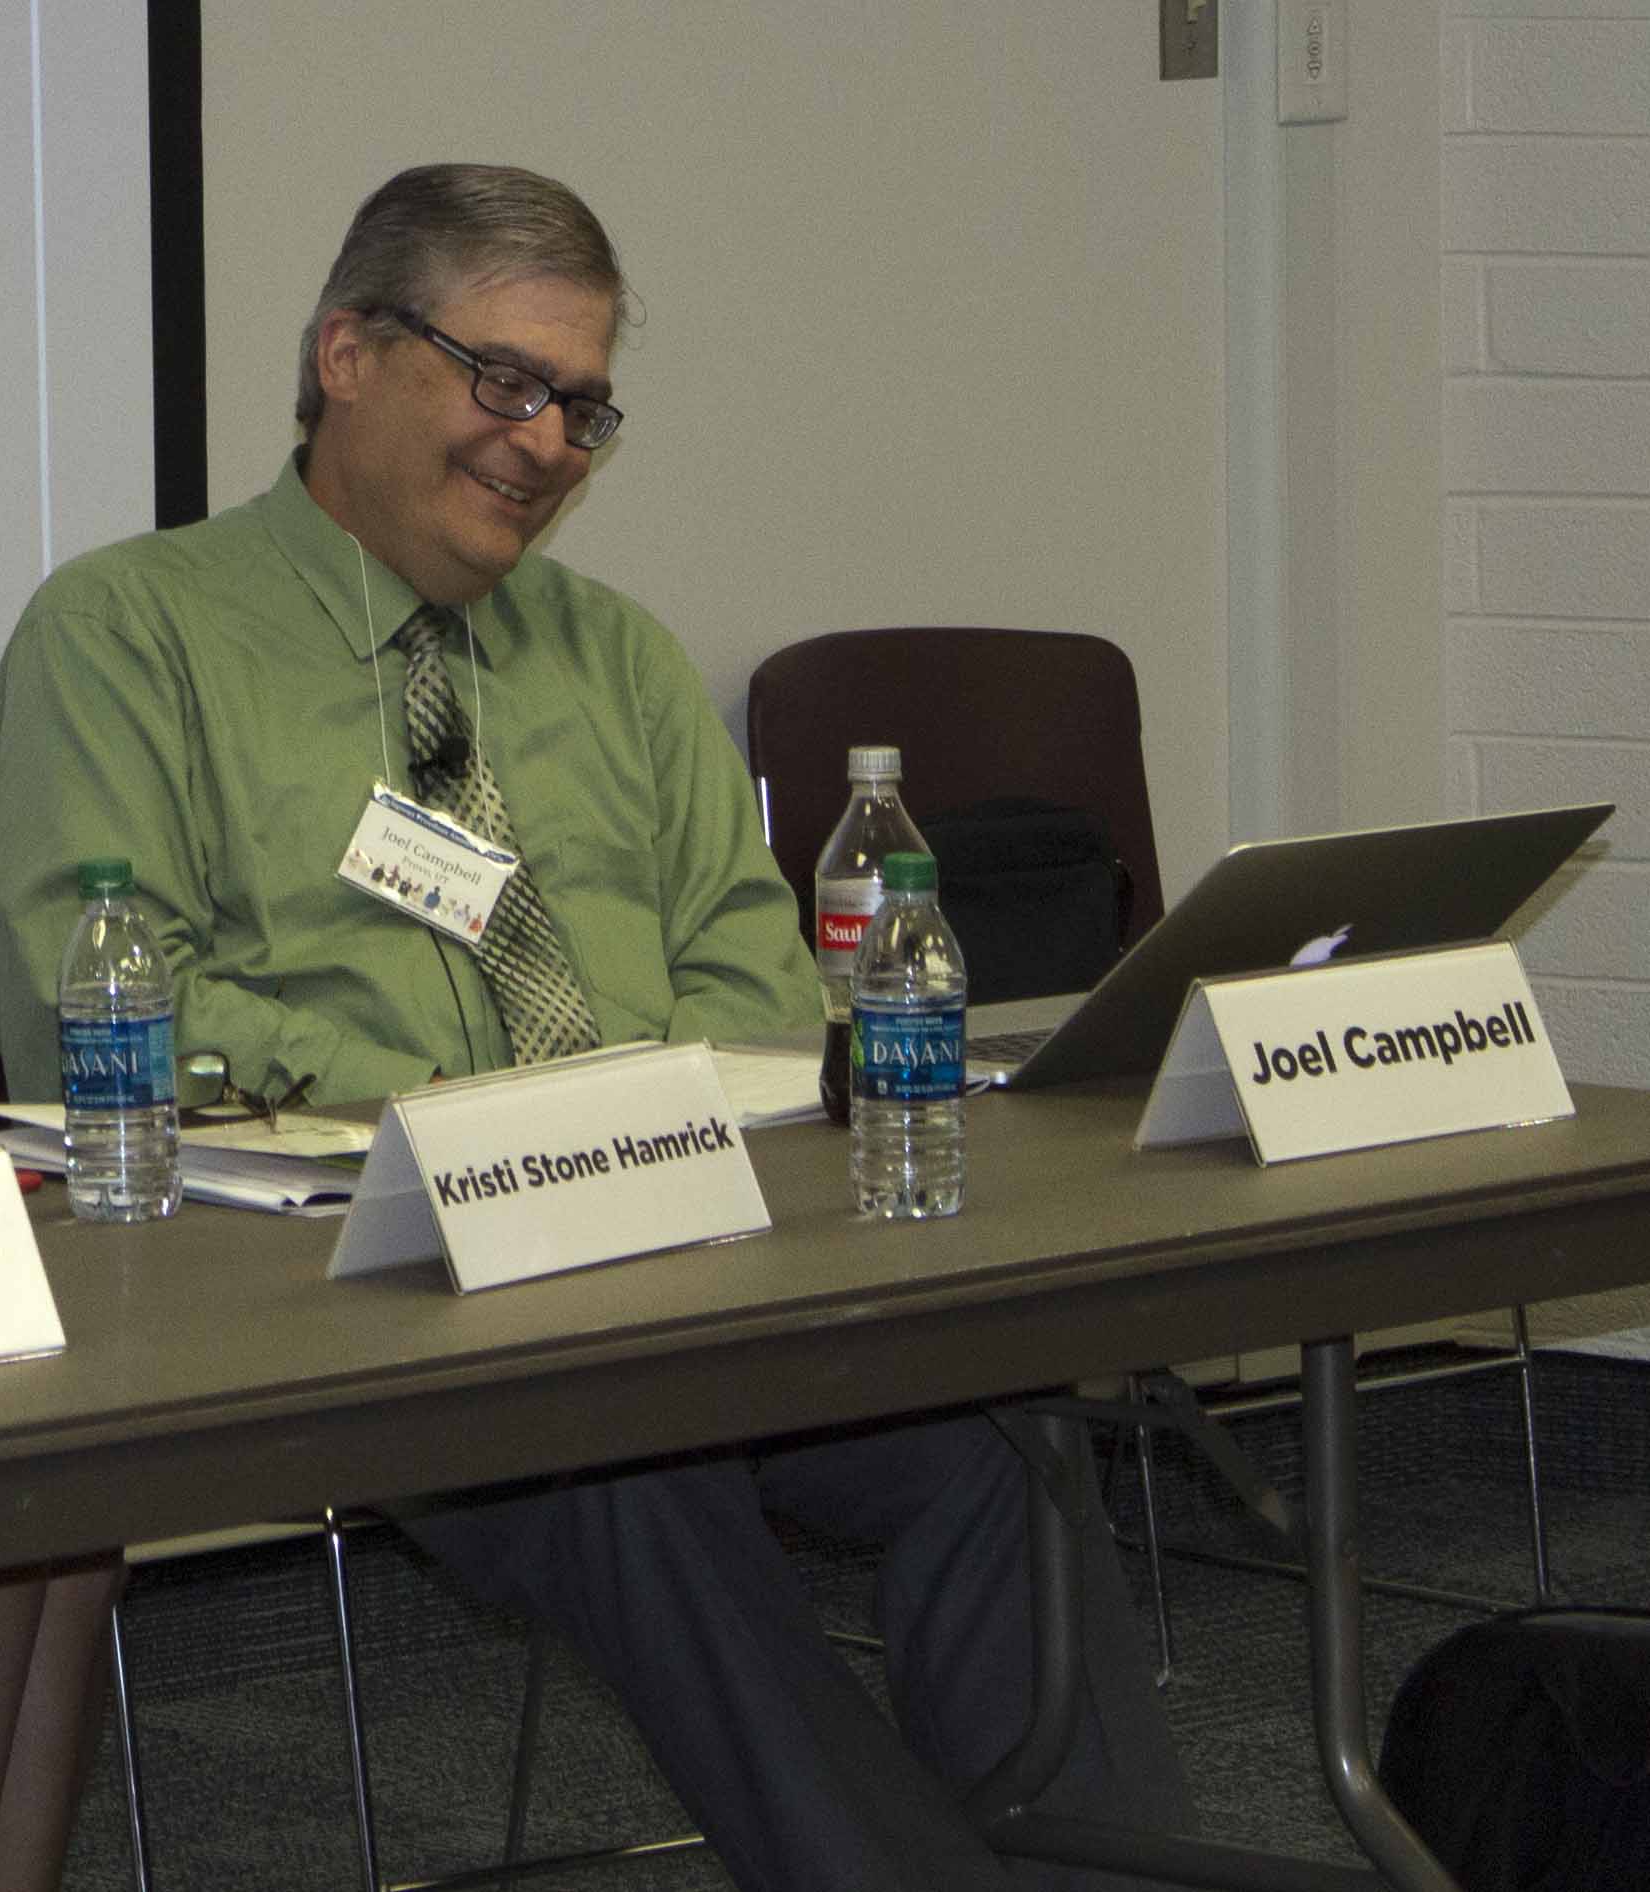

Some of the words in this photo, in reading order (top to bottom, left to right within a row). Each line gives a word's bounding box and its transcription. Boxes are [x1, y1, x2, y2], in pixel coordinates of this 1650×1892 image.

[382, 826, 412, 850] Joel
[413, 844, 482, 886] Campbell
[872, 1038, 960, 1070] DASANI
[1252, 1030, 1338, 1085] Joel
[1343, 1001, 1536, 1069] Campbell
[433, 1158, 519, 1207] Kristi
[521, 1147, 611, 1188] Stone
[612, 1117, 735, 1169] Hamrick
